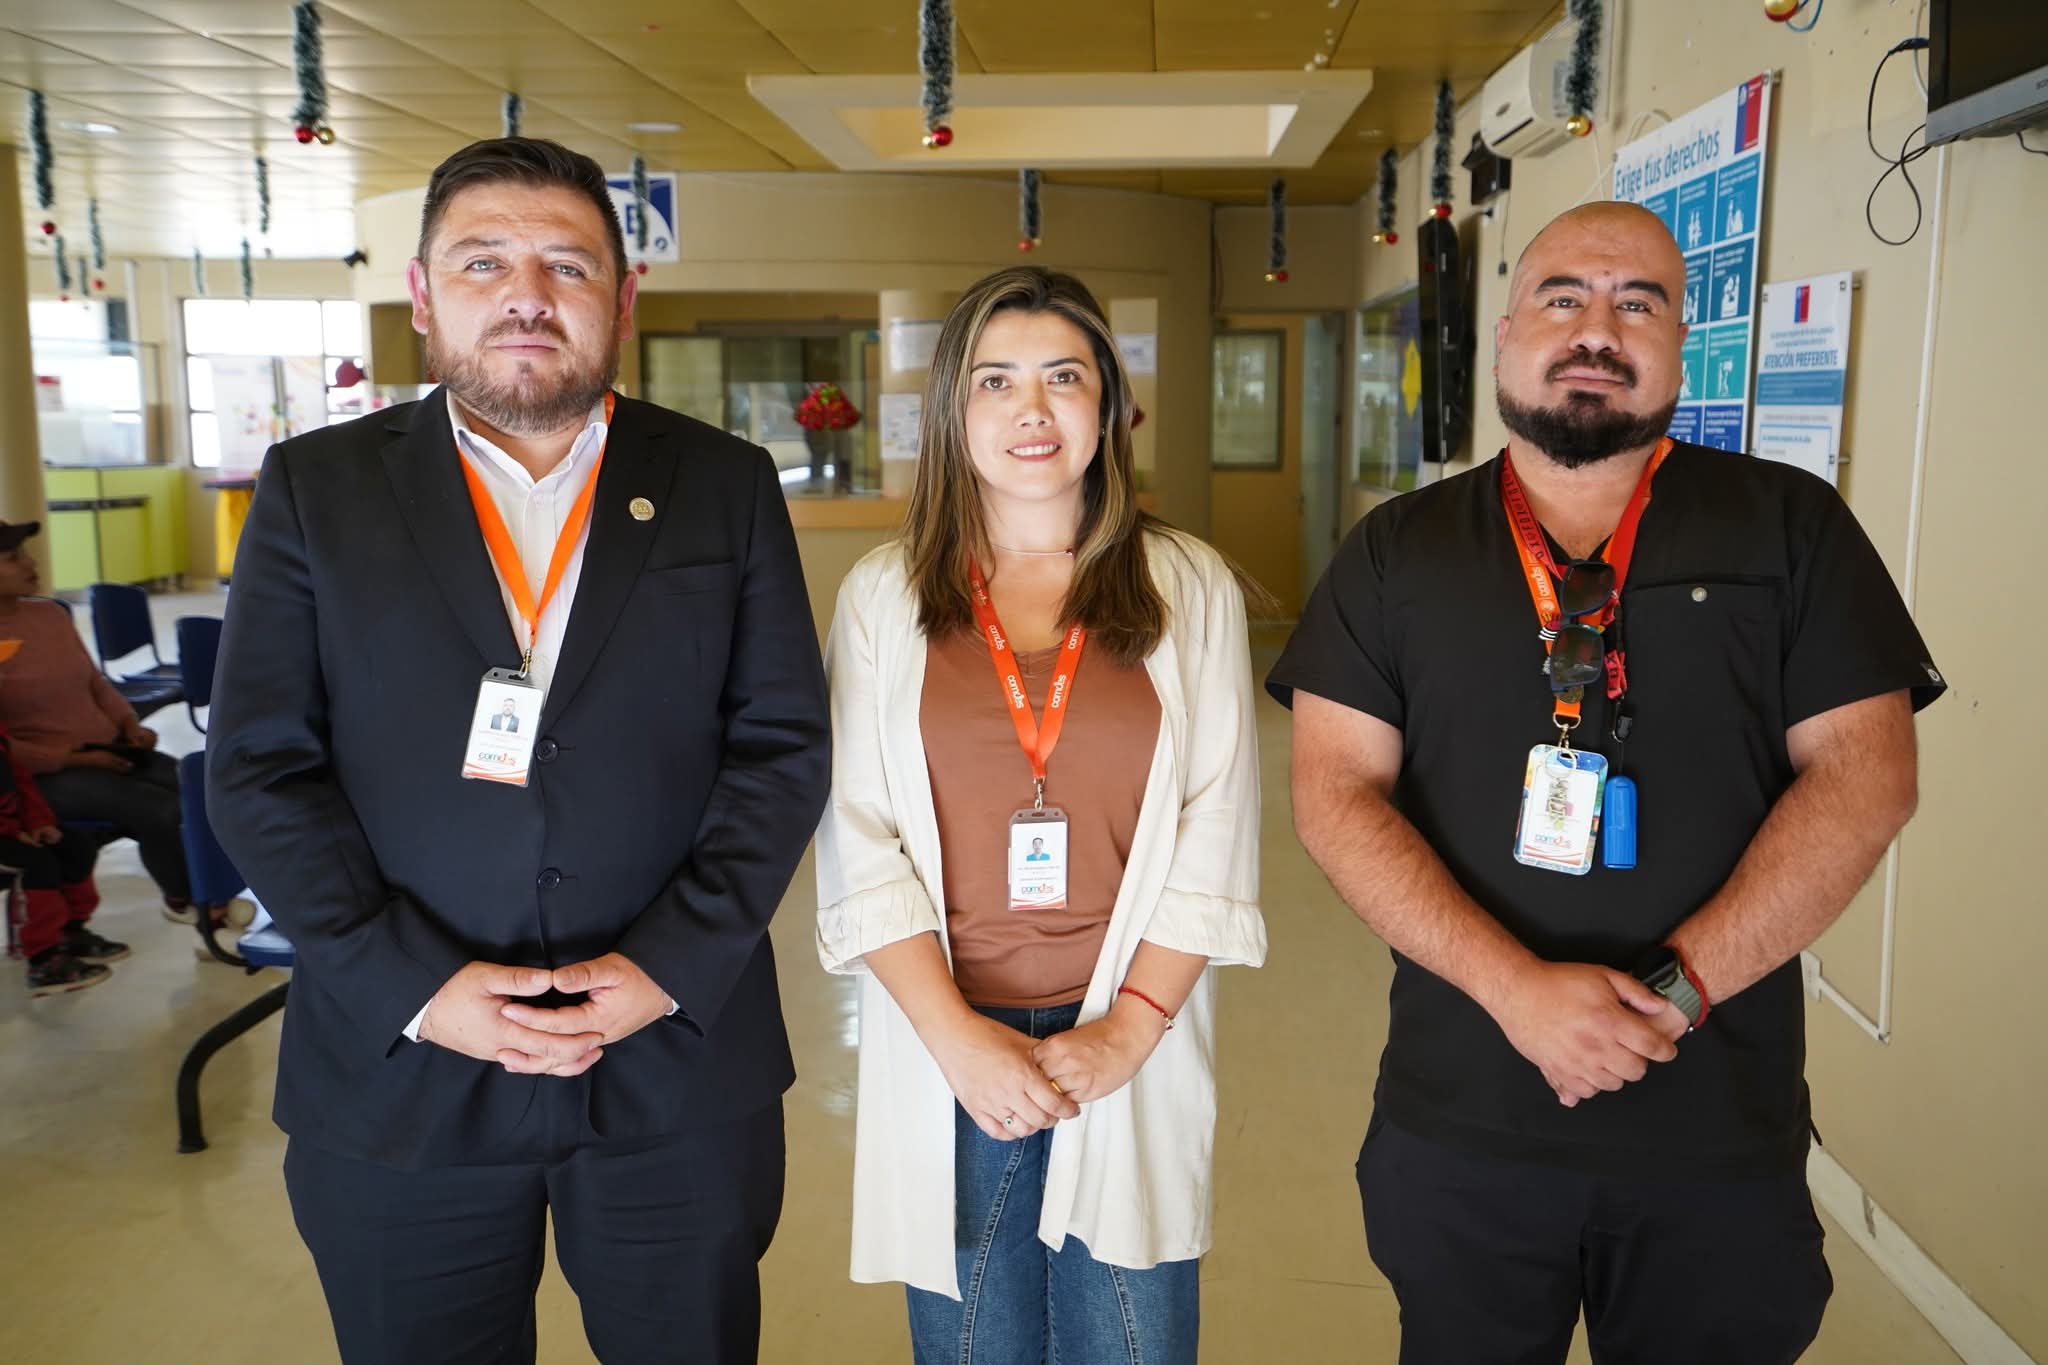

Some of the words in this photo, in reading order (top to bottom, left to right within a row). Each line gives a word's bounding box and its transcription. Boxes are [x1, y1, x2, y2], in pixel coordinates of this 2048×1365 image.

[1615, 165, 1642, 201] Exige
[1644, 156, 1661, 186] tus
[1664, 130, 1720, 179] derechos
[1764, 352, 1794, 369] ATENCIÓN
[1795, 350, 1839, 367] PREFERENTE
